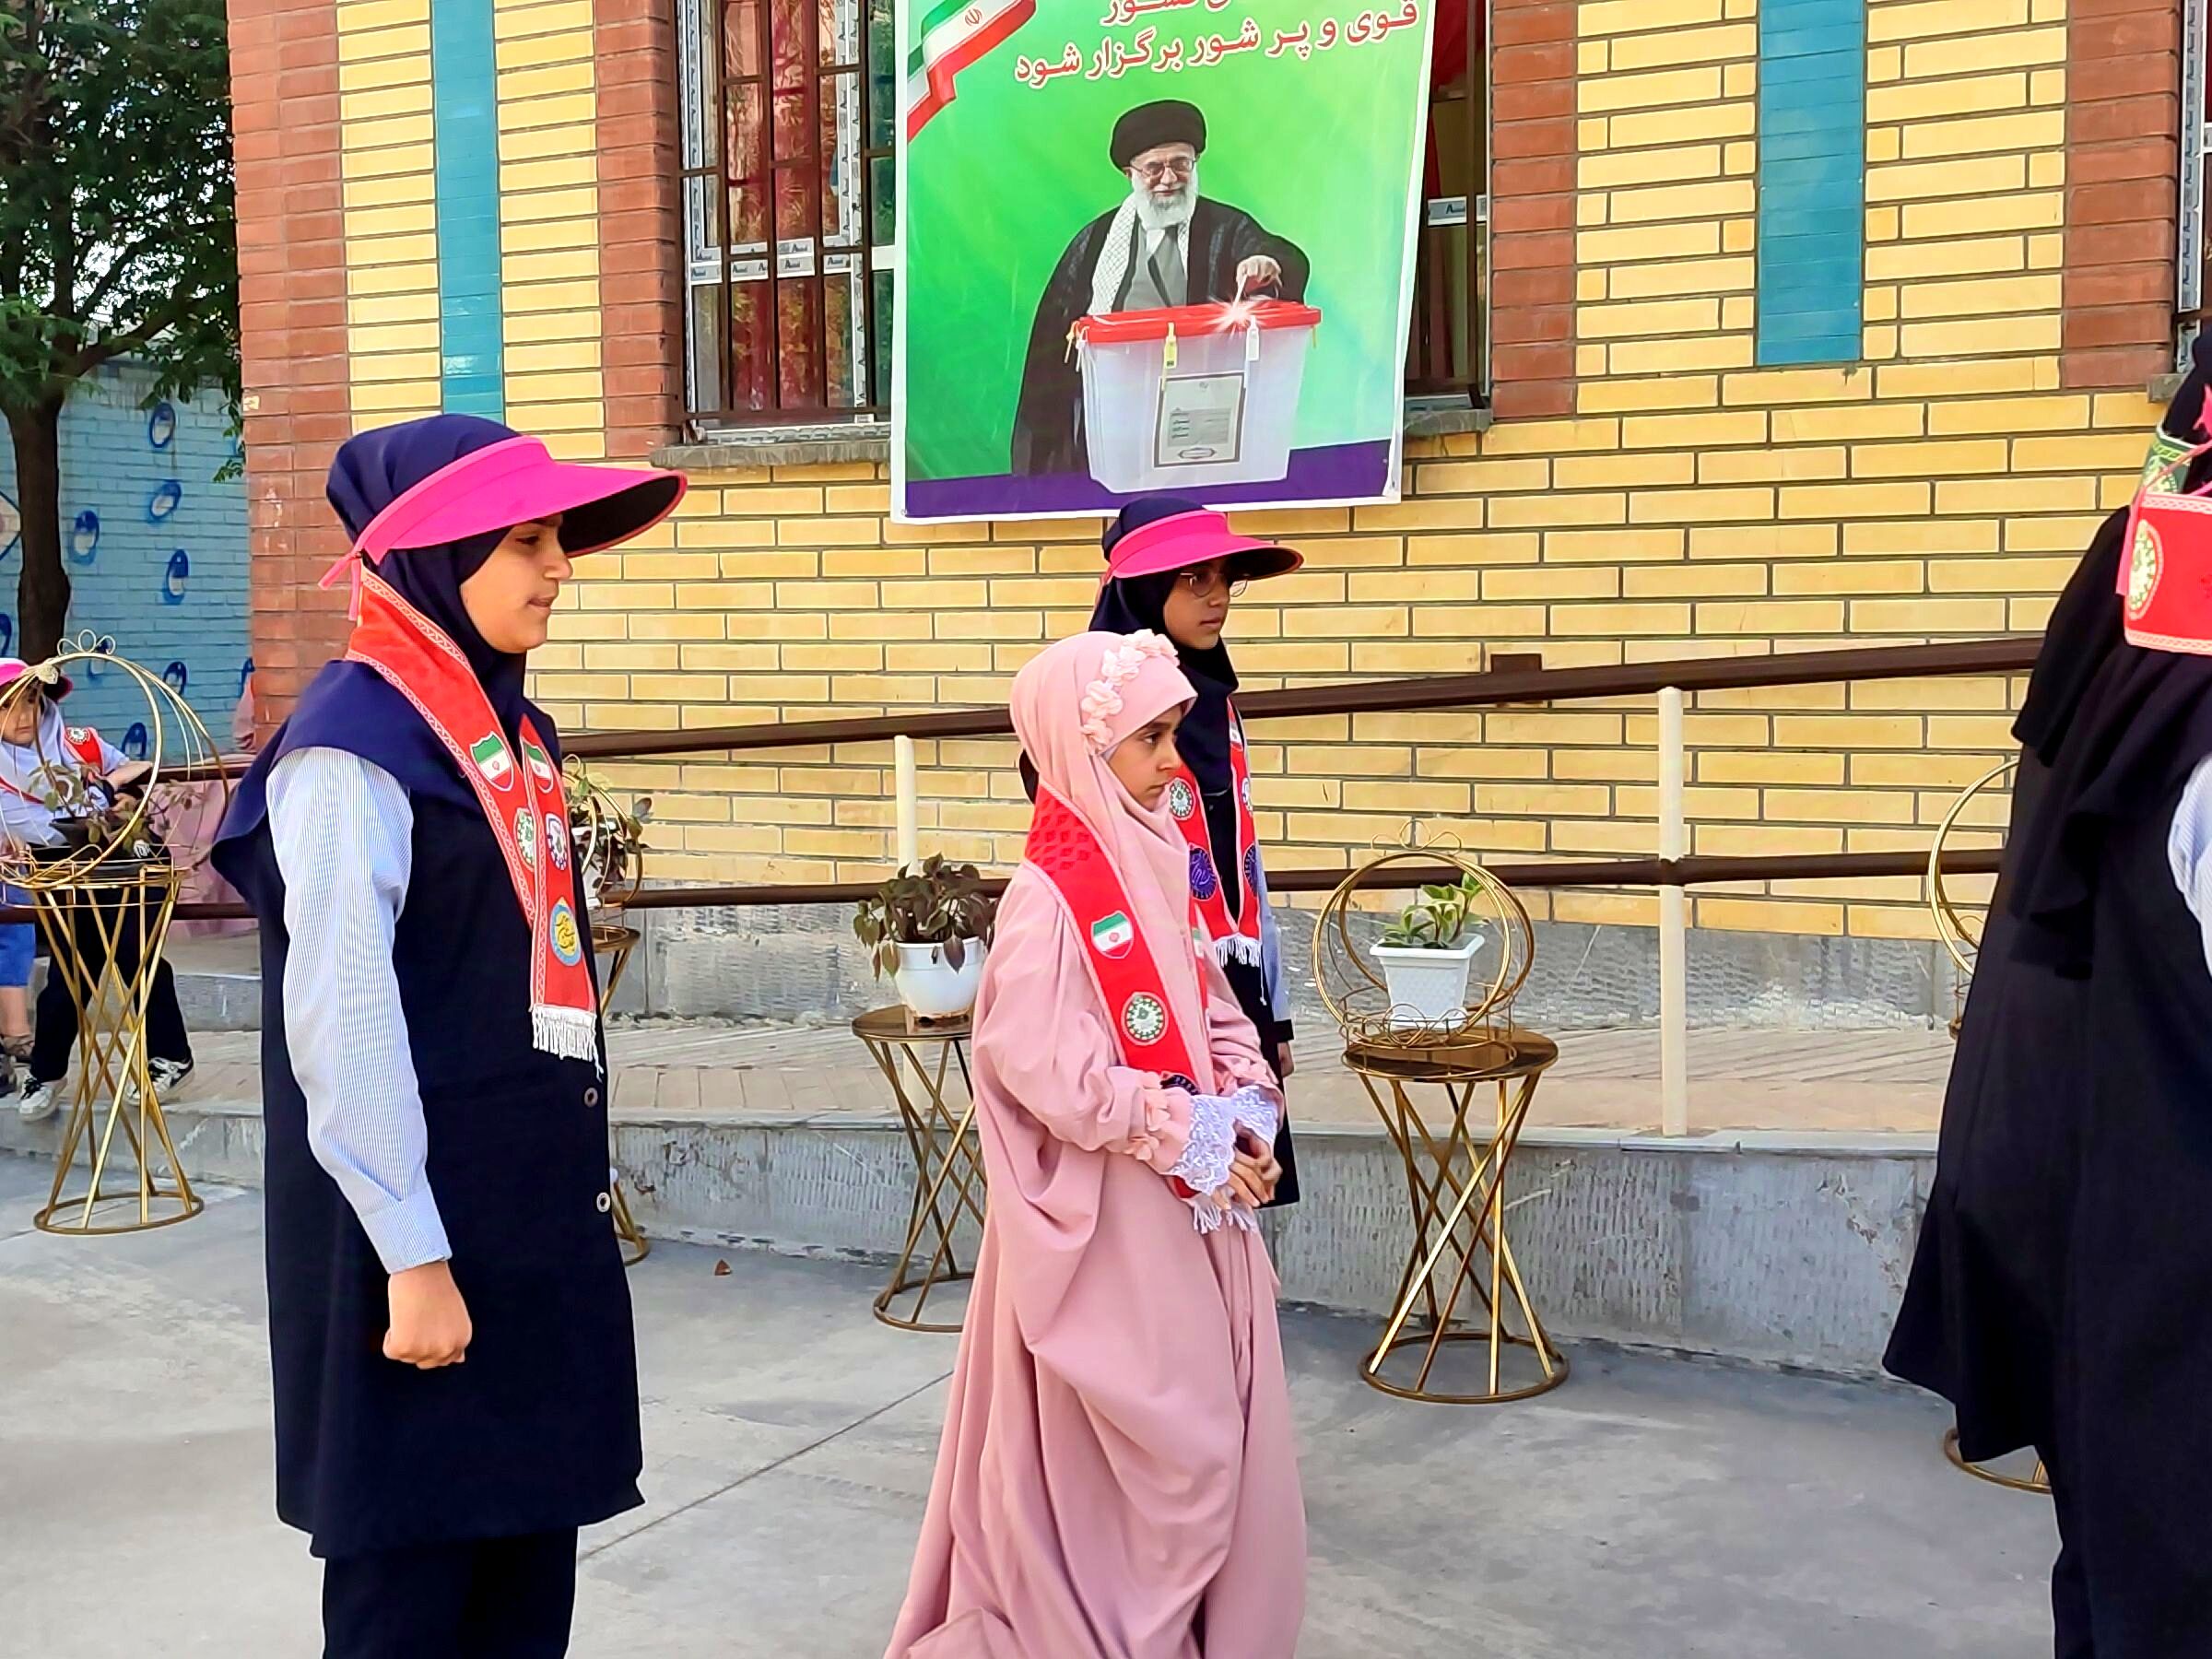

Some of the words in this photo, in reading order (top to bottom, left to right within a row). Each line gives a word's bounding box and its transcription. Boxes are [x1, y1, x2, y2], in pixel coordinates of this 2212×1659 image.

[1189, 19, 1260, 64] شور
[1267, 22, 1310, 58] پر
[1316, 19, 1337, 48] و
[1346, 0, 1418, 43] قوی
[1016, 44, 1080, 87] شود
[1087, 29, 1182, 77] برگزار
